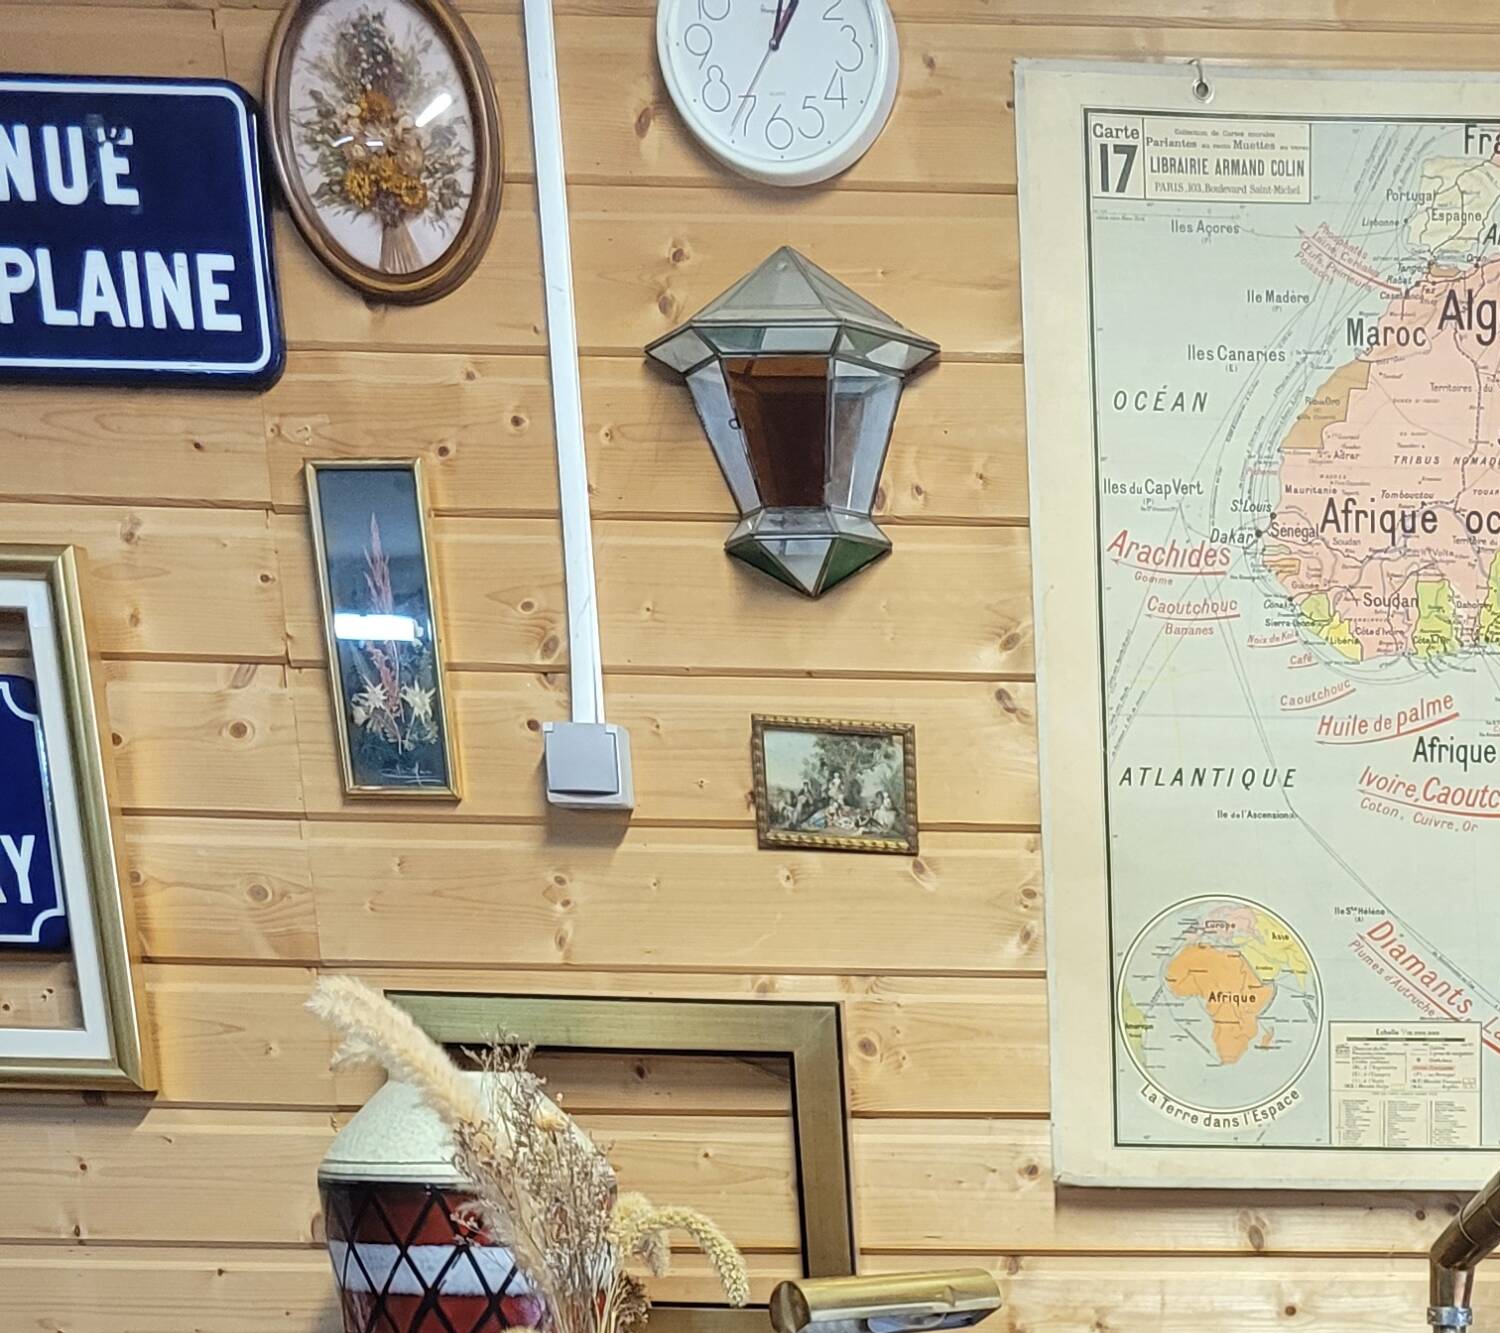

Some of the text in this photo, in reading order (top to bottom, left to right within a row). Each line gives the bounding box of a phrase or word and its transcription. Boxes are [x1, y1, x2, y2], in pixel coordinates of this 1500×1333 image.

[684, 23, 712, 70] 9
[835, 25, 863, 72] 3
[702, 65, 731, 113] 8
[824, 68, 848, 109] 4
[738, 95, 756, 136] 7
[766, 103, 793, 149] 6
[798, 96, 824, 139] 5
[1092, 123, 1140, 139] Carte
[1146, 137, 1275, 150] Parlantes Muettes
[1100, 143, 1138, 193] 17
[1150, 156, 1305, 177] LIBRAIRIE ARMAND COLIN
[1386, 188, 1436, 205] Portugal
[1171, 219, 1239, 238] Iles Açores
[1431, 209, 1482, 230] Espagne
[0, 247, 242, 331] PLAINE
[1247, 290, 1310, 304] Ile Madère
[1346, 318, 1427, 346] Maroc
[1187, 345, 1286, 361] Iles Canaries
[1430, 382, 1472, 393] Territoires
[1483, 383, 1493, 393] du
[1113, 385, 1208, 412] OCÉAN
[1393, 456, 1440, 465] TRIBUS
[1103, 479, 1204, 499] Iles du Cap Vert
[1285, 484, 1337, 494] Mauritanie
[1243, 500, 1272, 512] Louis
[1320, 497, 1438, 546] Afrique
[1210, 529, 1254, 544] Dakar
[1106, 530, 1230, 568] Arachides
[1134, 571, 1174, 586] Gomme
[1147, 595, 1238, 614] Caoutchouc
[1363, 593, 1419, 610] Soudan
[1164, 623, 1214, 636] Bananes
[1290, 653, 1312, 665] Café
[1280, 679, 1351, 706] Caoutchouc
[1317, 694, 1454, 736] Huile de palme
[1412, 736, 1496, 772] Afrique
[1120, 767, 1296, 789] ATLANTIQUE
[1462, 821, 1478, 833] Or
[0, 834, 36, 904] Y
[1348, 939, 1386, 976] Plumes
[1366, 921, 1474, 1015] Diamants
[1208, 991, 1256, 1007] Afrique
[1140, 1084, 1158, 1104] La
[1159, 1097, 1199, 1124] Terre
[1203, 1115, 1240, 1128] dans
[1244, 1087, 1299, 1126] l'Espace
